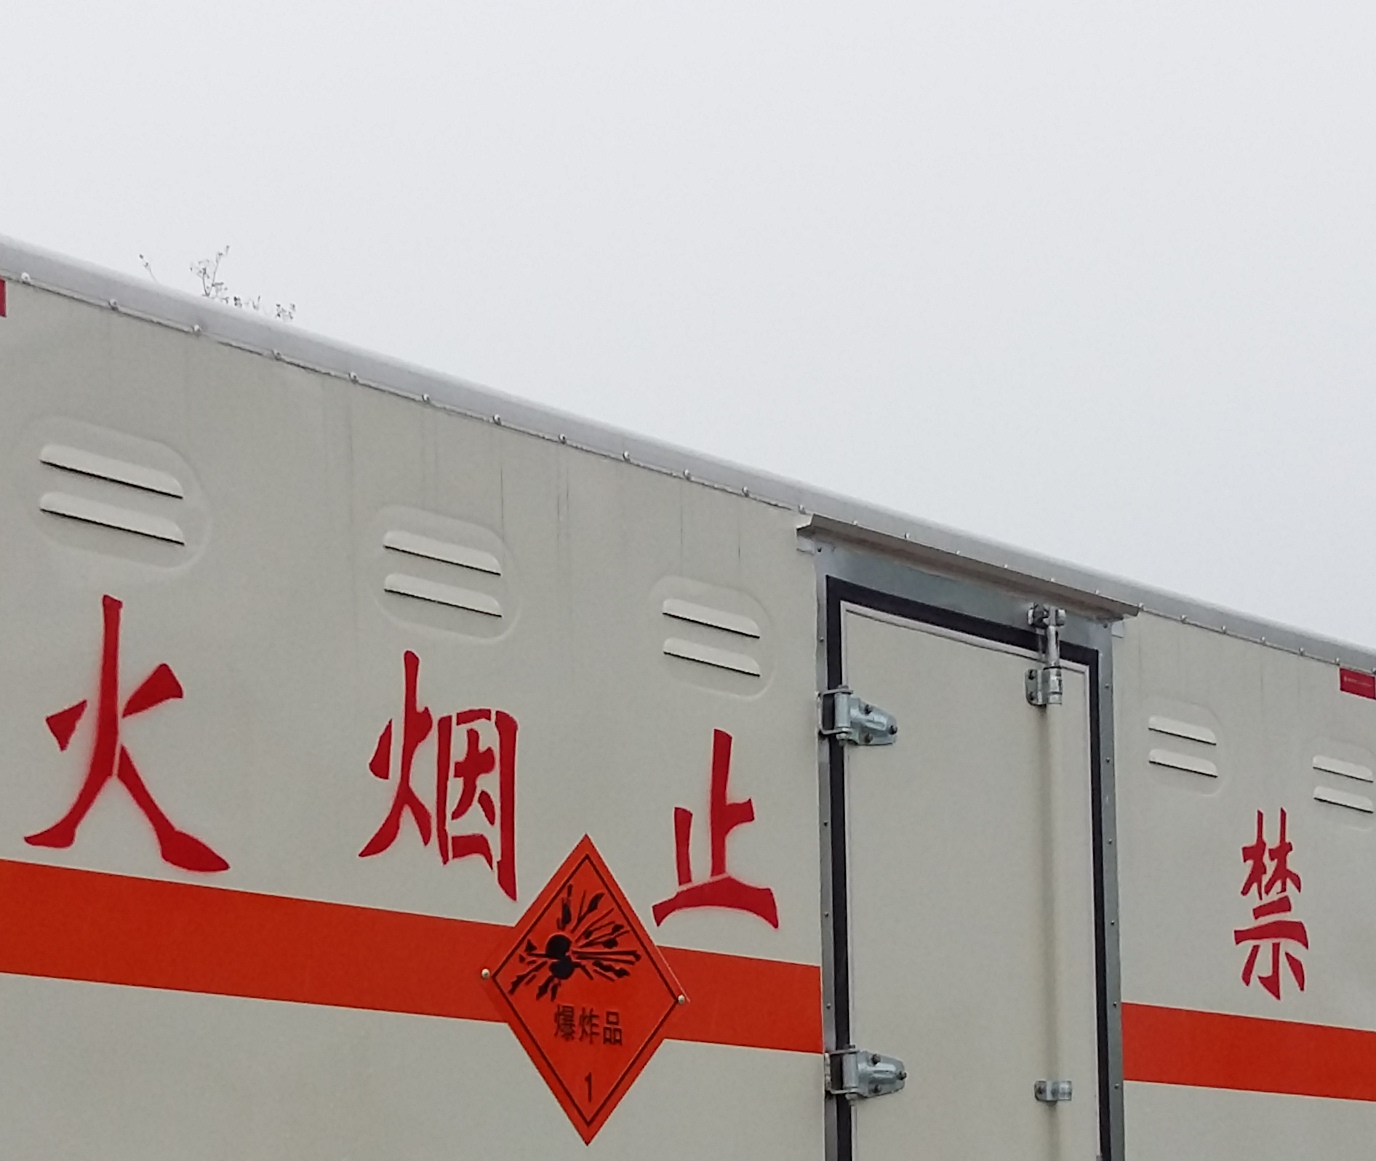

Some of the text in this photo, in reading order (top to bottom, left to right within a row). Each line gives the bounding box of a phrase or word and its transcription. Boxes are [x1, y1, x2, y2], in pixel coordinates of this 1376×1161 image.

[23, 594, 1309, 1001] 火 烟 止 禁
[553, 1003, 623, 1047] 爆炸品
[583, 1071, 593, 1102] 1
